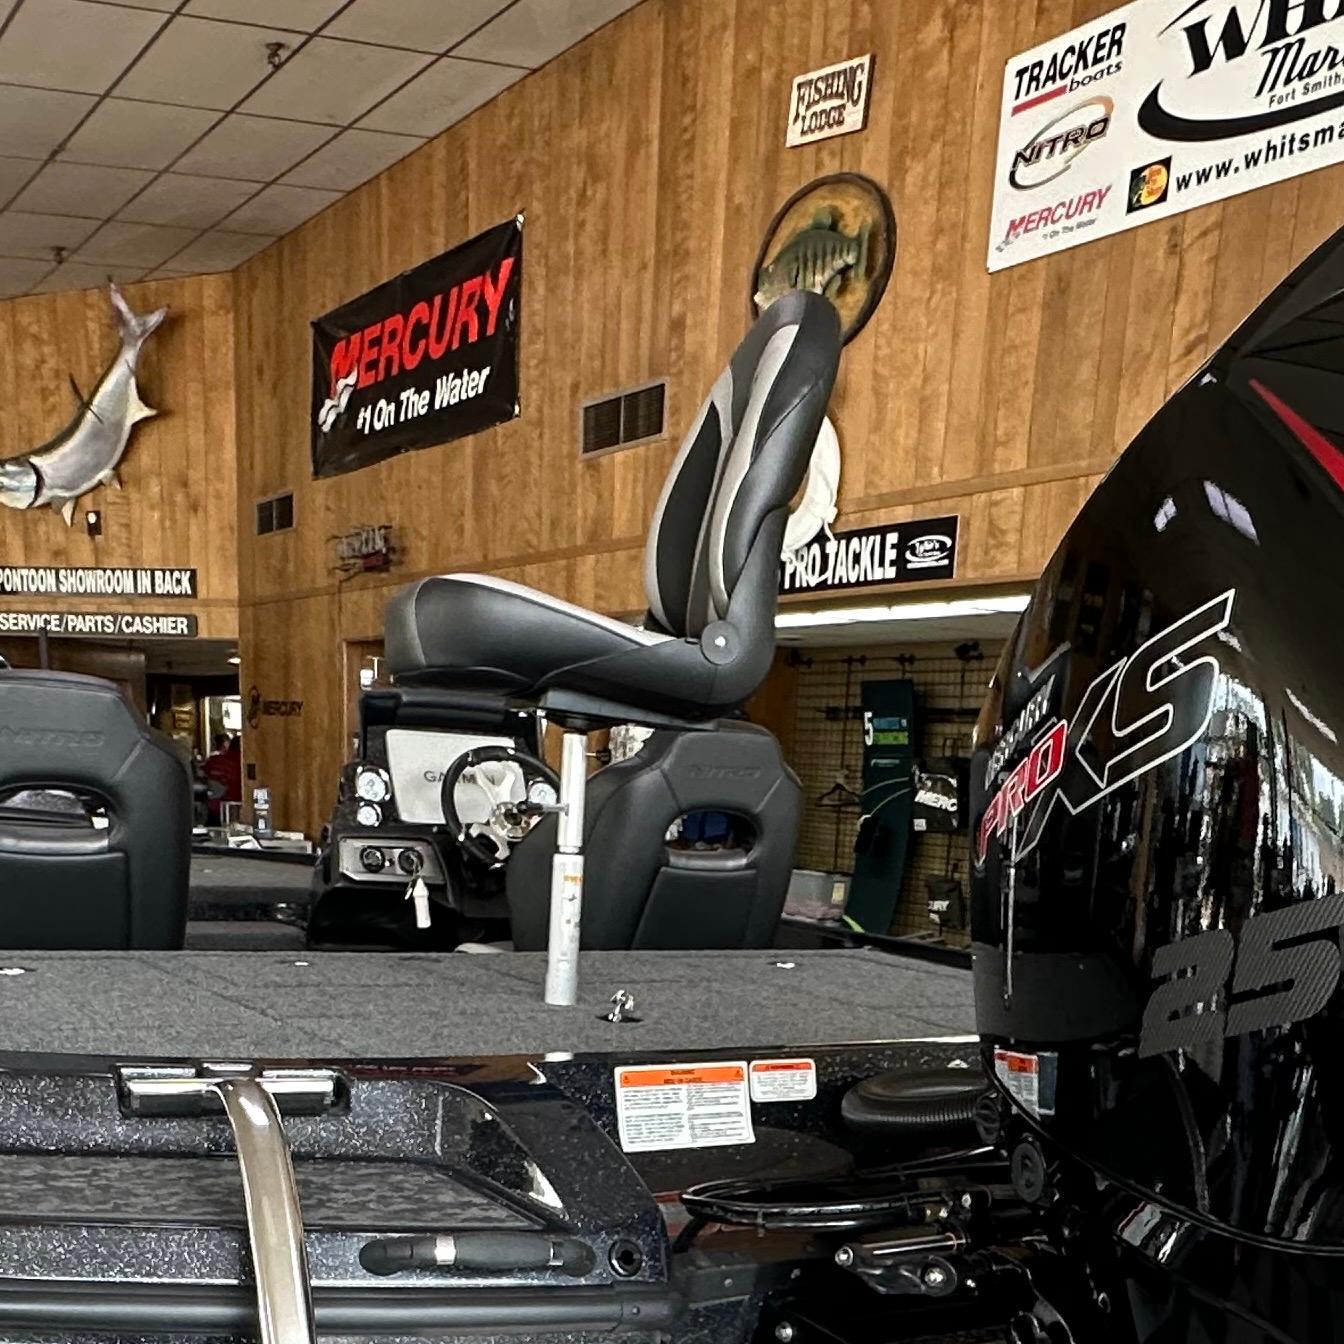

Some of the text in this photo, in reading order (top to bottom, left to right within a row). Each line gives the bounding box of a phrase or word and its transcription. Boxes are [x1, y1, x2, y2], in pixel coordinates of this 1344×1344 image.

[1013, 22, 1127, 100] TRACKER
[1068, 60, 1124, 94] boats
[794, 63, 864, 125] FISHING
[800, 103, 846, 137] LODGE
[1268, 90, 1296, 108] Fort
[1012, 116, 1110, 170] NITRO
[1004, 184, 1113, 240] MERCURY
[330, 257, 515, 400] MERCURY
[357, 366, 491, 435] #1 On The Water
[58, 569, 135, 594] SHOWROOM
[137, 569, 151, 593] IN
[154, 570, 192, 595] BACK
[826, 531, 899, 586] TACKLE
[974, 719, 1068, 868] PRO
